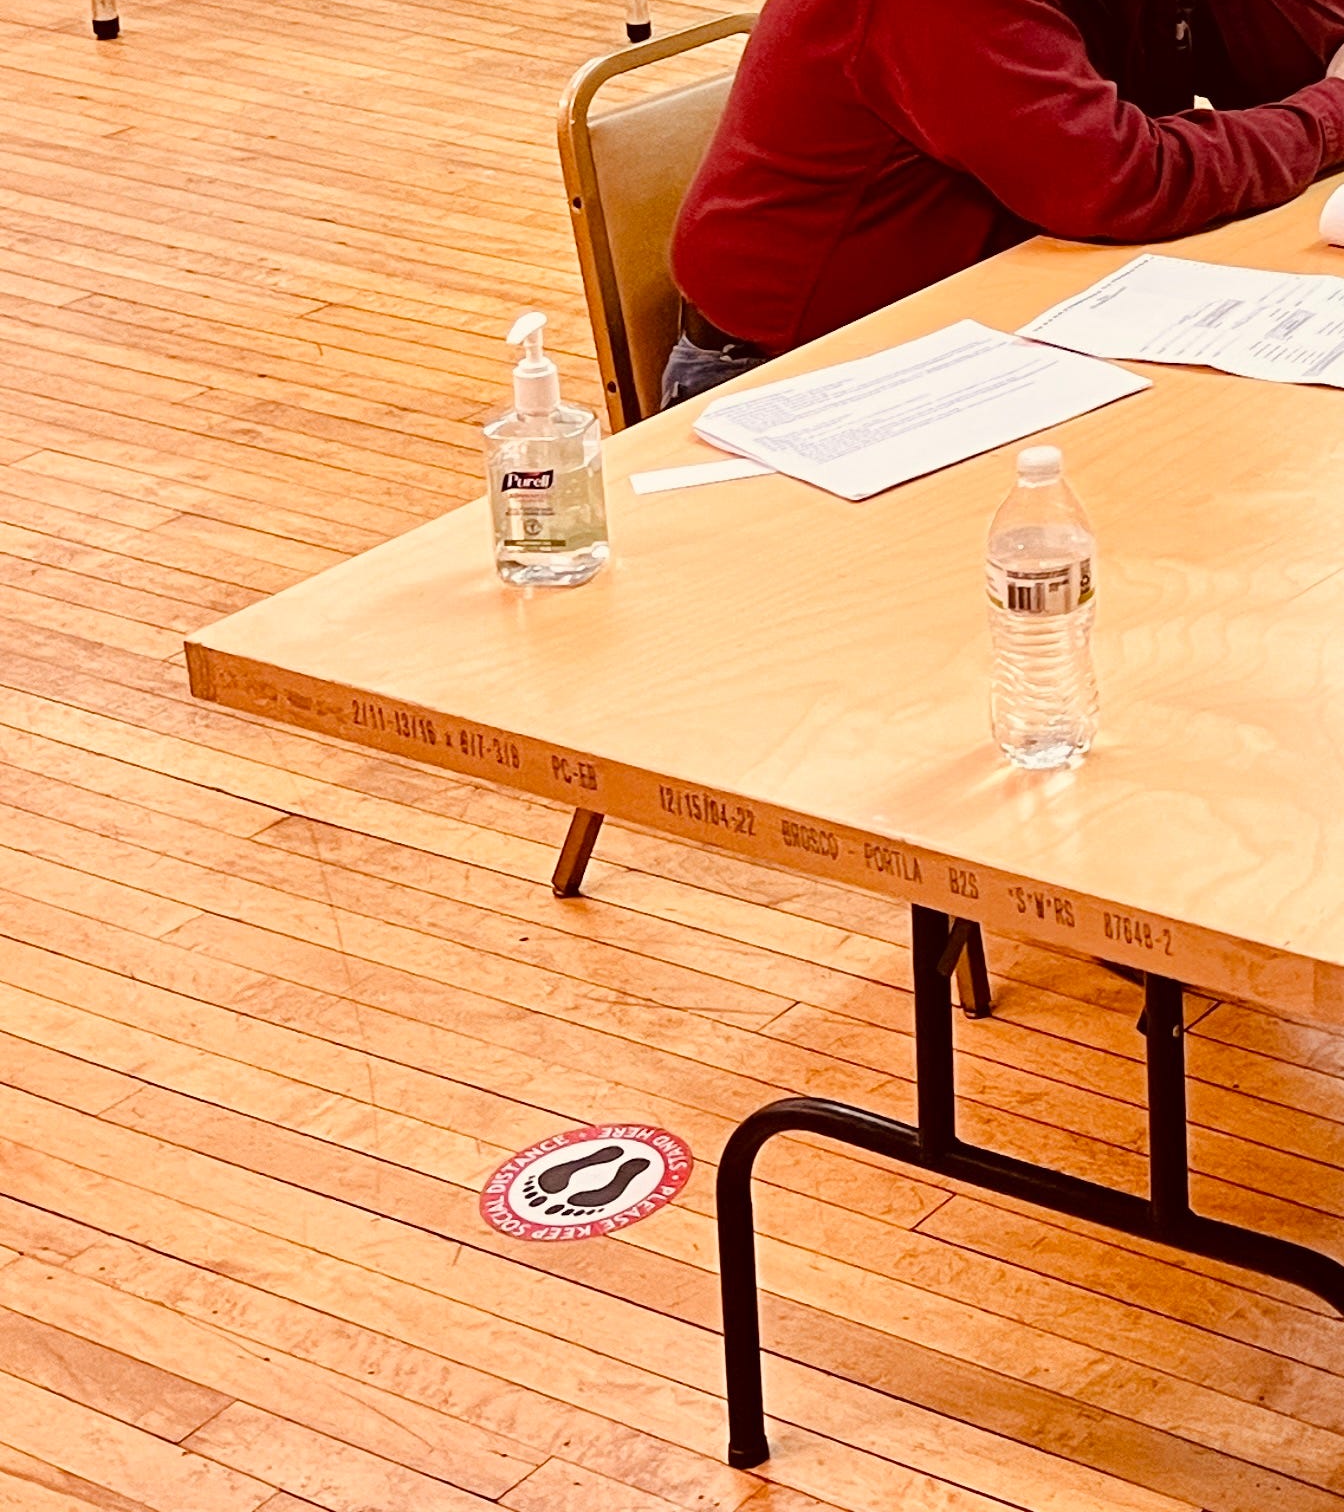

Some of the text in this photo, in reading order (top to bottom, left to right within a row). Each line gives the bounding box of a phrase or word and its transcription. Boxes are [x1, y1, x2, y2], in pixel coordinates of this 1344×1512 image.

[506, 473, 551, 488] Purell
[863, 841, 923, 885] PORTLA
[948, 867, 980, 900] B2S
[598, 1126, 689, 1172] STAND HERE
[485, 1134, 677, 1240] PLEASE KEEP SOCIAL DISTANCE
